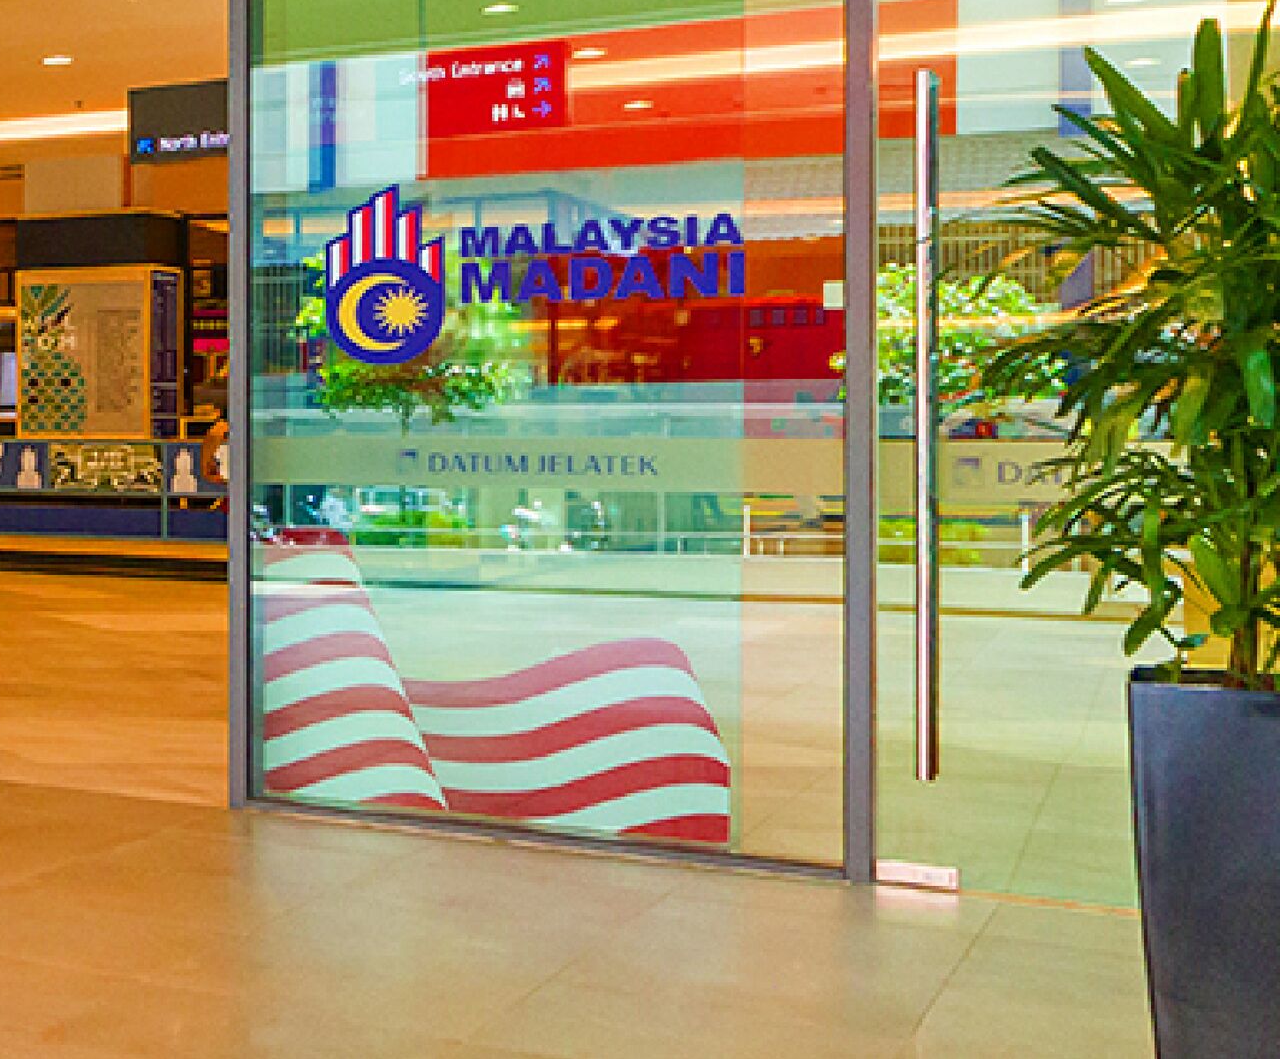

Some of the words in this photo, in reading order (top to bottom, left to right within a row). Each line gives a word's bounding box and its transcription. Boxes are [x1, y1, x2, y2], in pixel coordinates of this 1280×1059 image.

[460, 213, 744, 257] MALAYSIA
[460, 252, 745, 303] MADANI
[427, 451, 529, 475] DATUM
[536, 451, 659, 477] JELATEK
